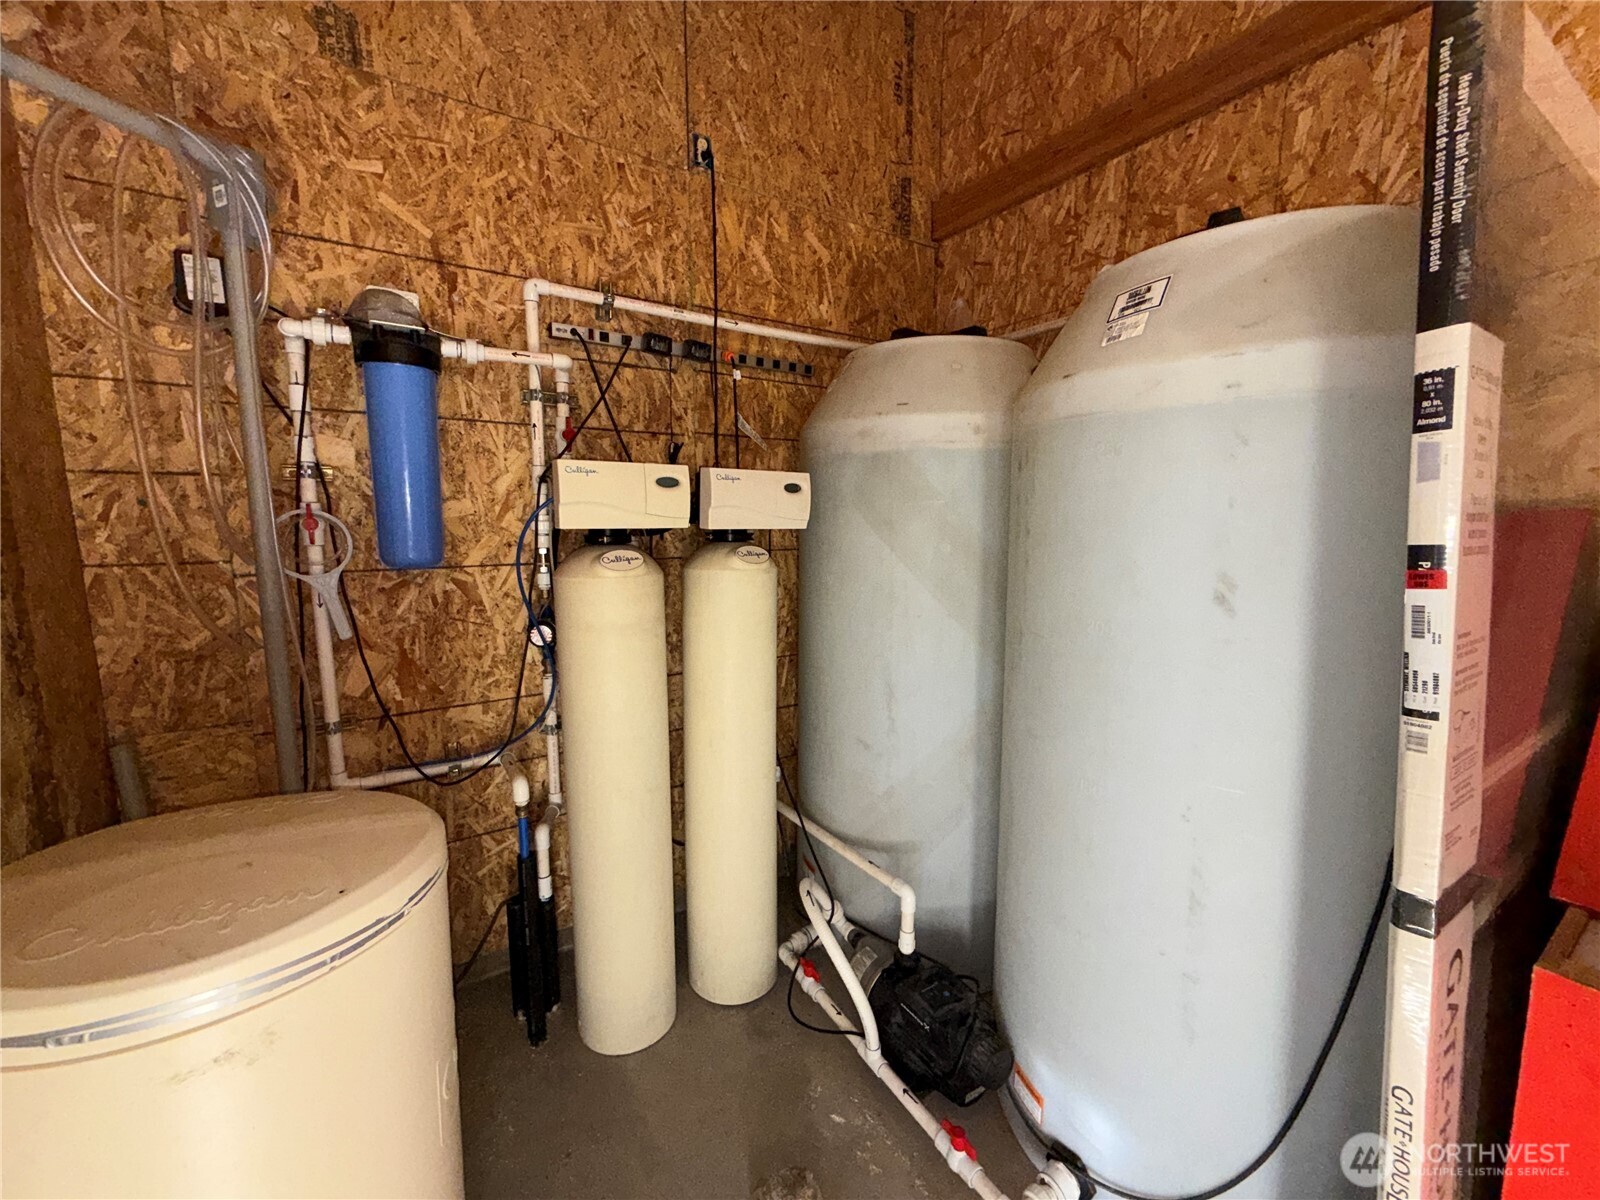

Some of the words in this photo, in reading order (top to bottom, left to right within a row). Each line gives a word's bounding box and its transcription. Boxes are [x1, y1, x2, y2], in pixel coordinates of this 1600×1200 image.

[1439, 36, 1454, 73] Puerta
[1438, 73, 1452, 87] de
[1435, 87, 1450, 137] seguridad
[1453, 72, 1473, 132] Heavy-Duty
[1436, 137, 1449, 150] de
[1455, 132, 1470, 158] Steel
[1435, 151, 1446, 178] acero
[1432, 178, 1444, 201] para
[1450, 158, 1468, 200] Security
[1429, 201, 1446, 237] trabajo
[1451, 200, 1466, 224] Door
[1428, 237, 1442, 272] pesado
[1416, 415, 1446, 426] Almond
[564, 465, 599, 475] Culligan
[715, 473, 742, 482] Culligan
[601, 555, 643, 565] Culligan
[736, 550, 768, 559] Culligan
